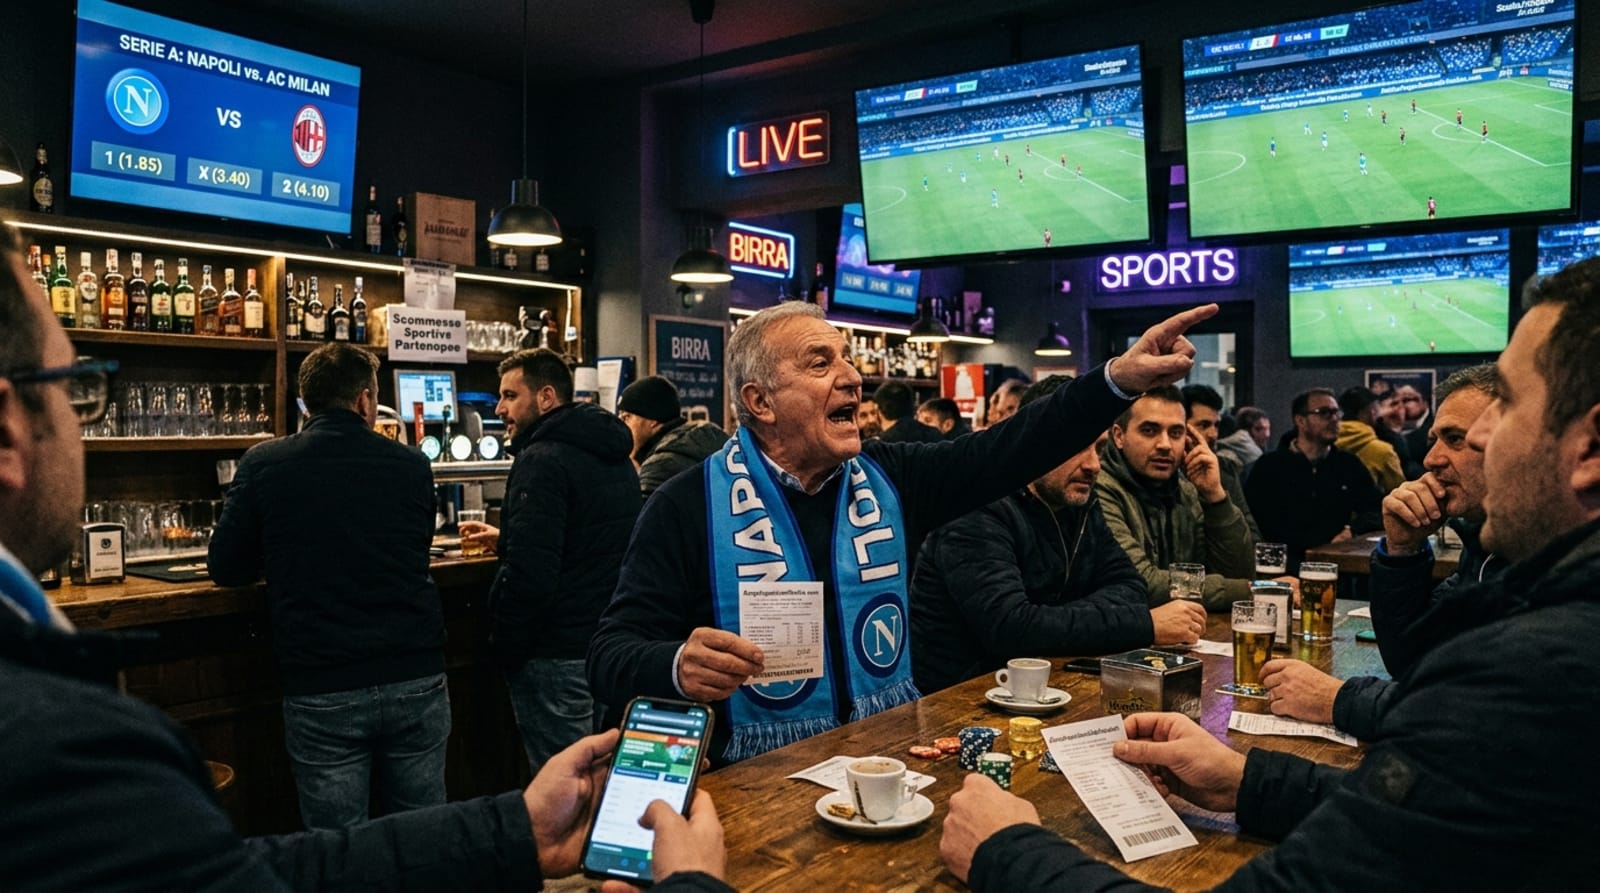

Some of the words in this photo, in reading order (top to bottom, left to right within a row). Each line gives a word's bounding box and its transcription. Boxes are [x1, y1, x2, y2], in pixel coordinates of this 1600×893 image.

[120, 34, 166, 59] SERIE
[167, 46, 184, 63] A:
[187, 50, 241, 77] NAPOLI
[244, 67, 264, 82] vs.
[266, 70, 286, 87] AC
[287, 74, 330, 97] MILAN
[216, 107, 242, 129] VS
[738, 118, 824, 169] LIVE
[105, 151, 113, 166] 1
[118, 152, 163, 176] (1.85)
[198, 166, 209, 181] X
[212, 169, 251, 189] (3.40)
[282, 179, 292, 194] 2
[294, 182, 330, 202] (4.10)
[730, 232, 789, 270] BIRRA
[1101, 248, 1235, 288] SPORTS
[404, 327, 452, 340] Sportive
[671, 336, 712, 362] BIRRA
[871, 615, 898, 657] N
